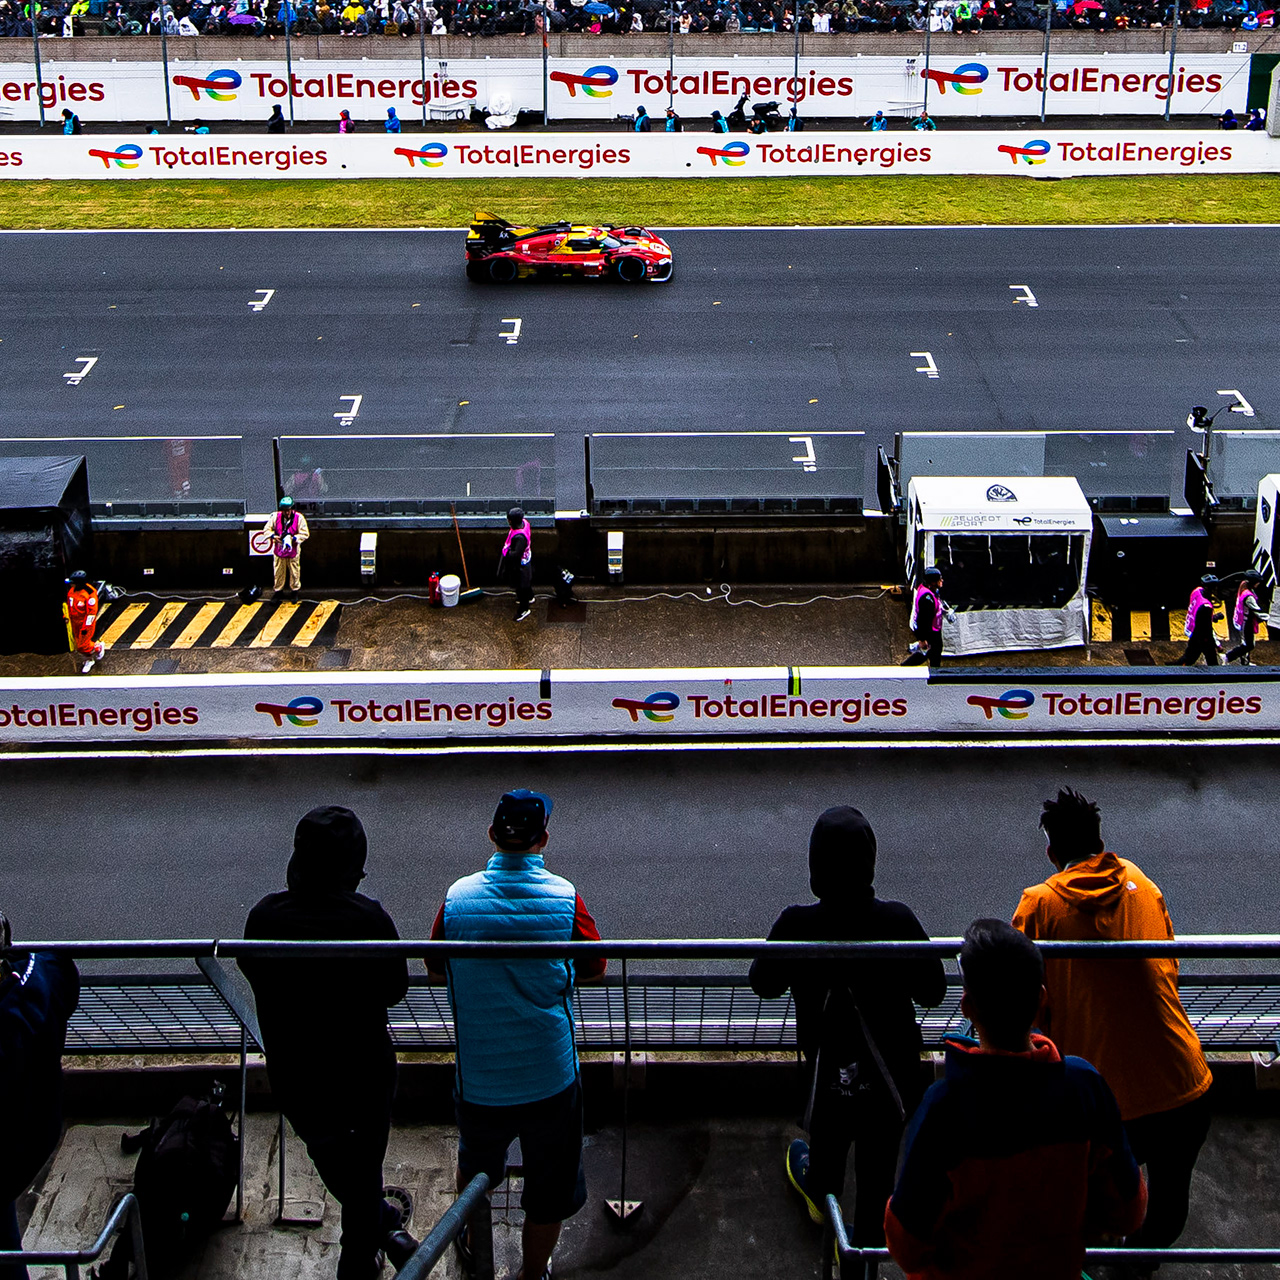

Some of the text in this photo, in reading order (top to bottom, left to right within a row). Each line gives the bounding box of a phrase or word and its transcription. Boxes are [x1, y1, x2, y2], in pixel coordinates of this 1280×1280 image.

[250, 72, 477, 105] TotalEnergies
[627, 70, 853, 103] TotalEnergies
[997, 67, 1222, 100] TotalEnergies
[149, 145, 327, 170] TotalEnergies
[454, 144, 630, 169] TotalEnergies
[756, 142, 931, 167] TotalEnergies
[1057, 141, 1232, 166] TotalEnergies
[1034, 518, 1076, 527] TotalEnergies
[331, 696, 552, 727] TotalEnergies
[687, 692, 907, 723] TotalEnergies
[1042, 690, 1261, 720] TotalEnergies
